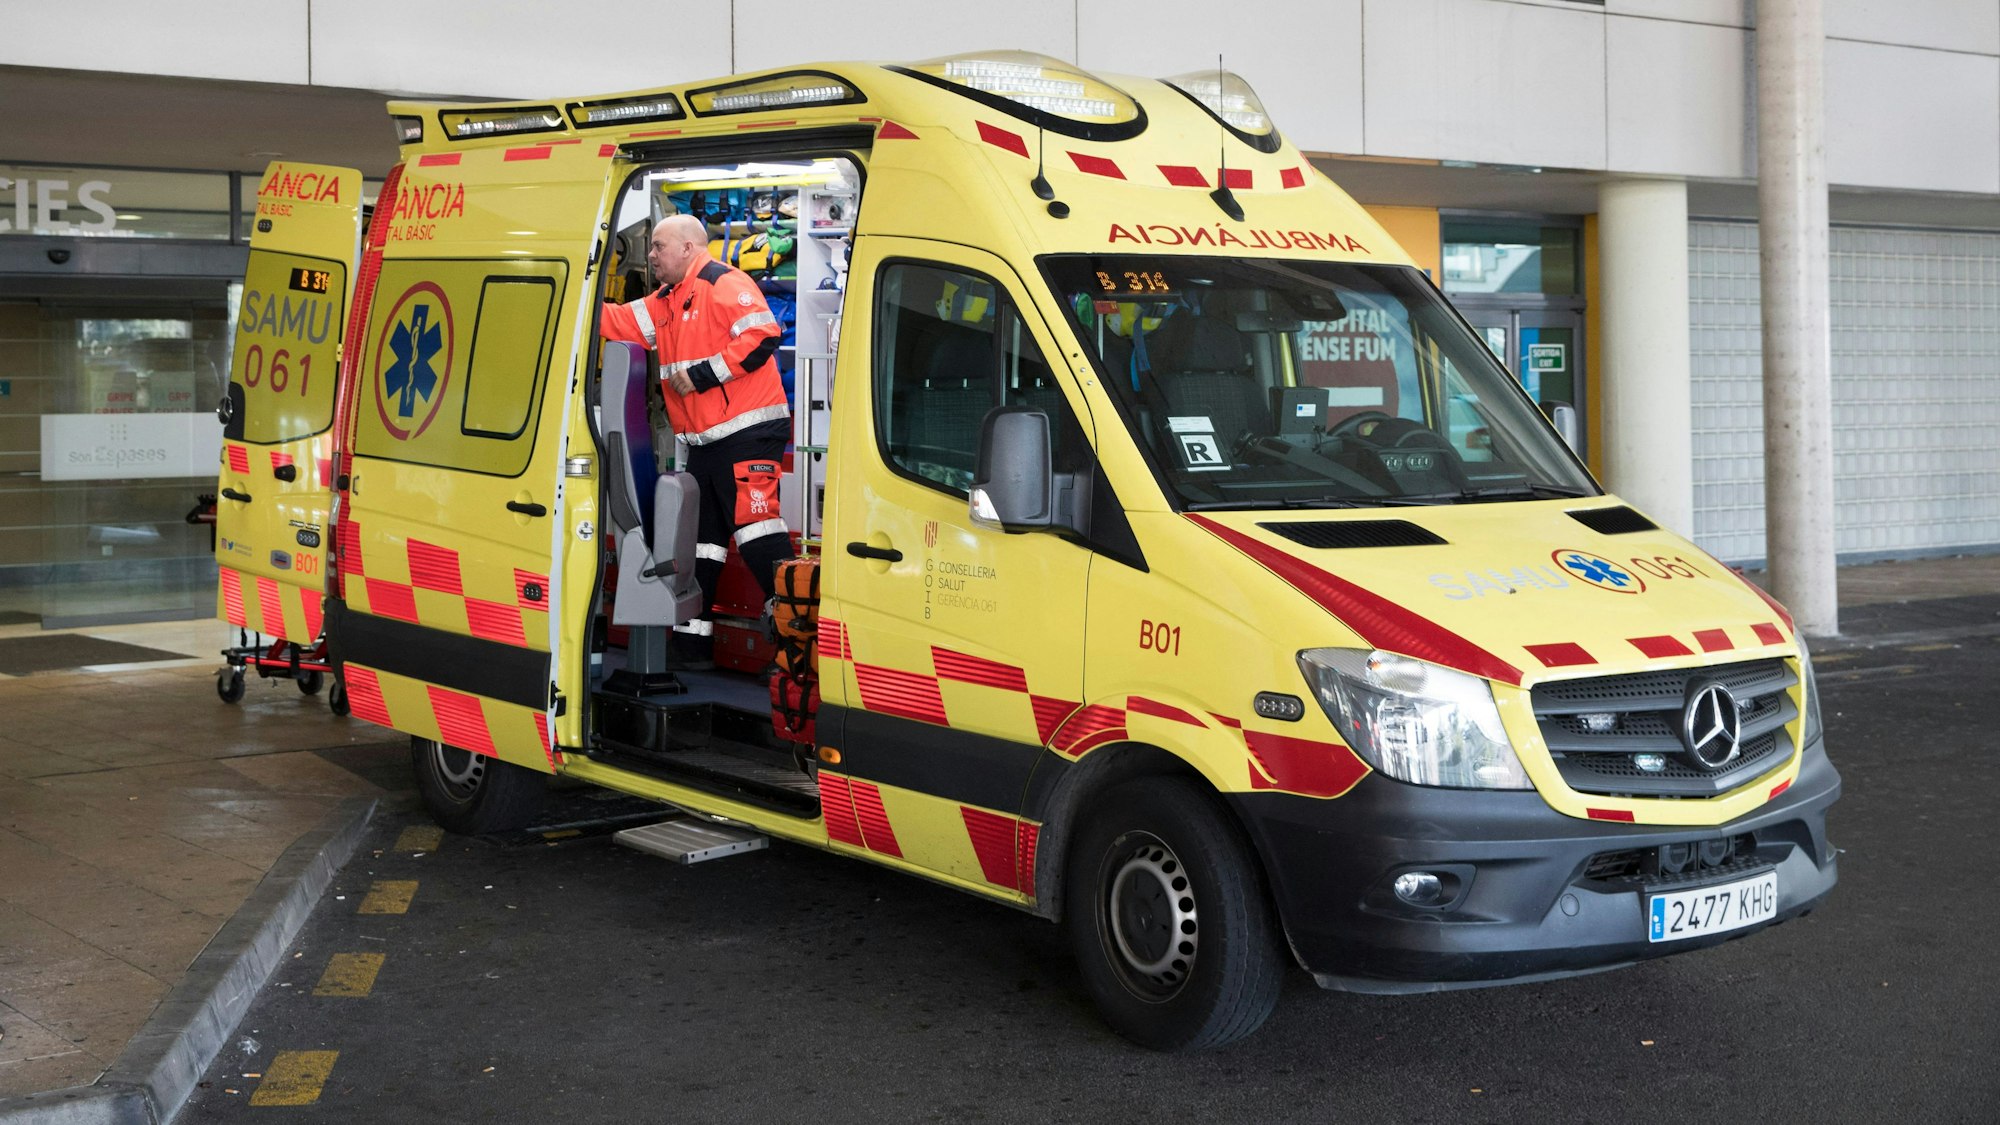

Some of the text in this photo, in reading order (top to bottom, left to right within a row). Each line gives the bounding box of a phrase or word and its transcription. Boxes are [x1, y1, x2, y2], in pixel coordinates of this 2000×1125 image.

[257, 164, 339, 203] ÀNCIA
[301, 270, 309, 288] B
[1096, 271, 1170, 290] B 314
[241, 290, 332, 344] SAMU
[1354, 336, 1396, 361] FUM
[244, 344, 311, 397] 061
[1539, 359, 1553, 367] EXIT
[95, 446, 167, 469] Espases
[1185, 442, 1214, 461] R
[938, 561, 997, 580] CONSELLERIA
[938, 577, 965, 592] SALUT
[1428, 564, 1570, 601] SAMU
[981, 599, 997, 613] 061
[1670, 882, 1772, 933] 2477 KHG
[1654, 922, 1661, 933] E
